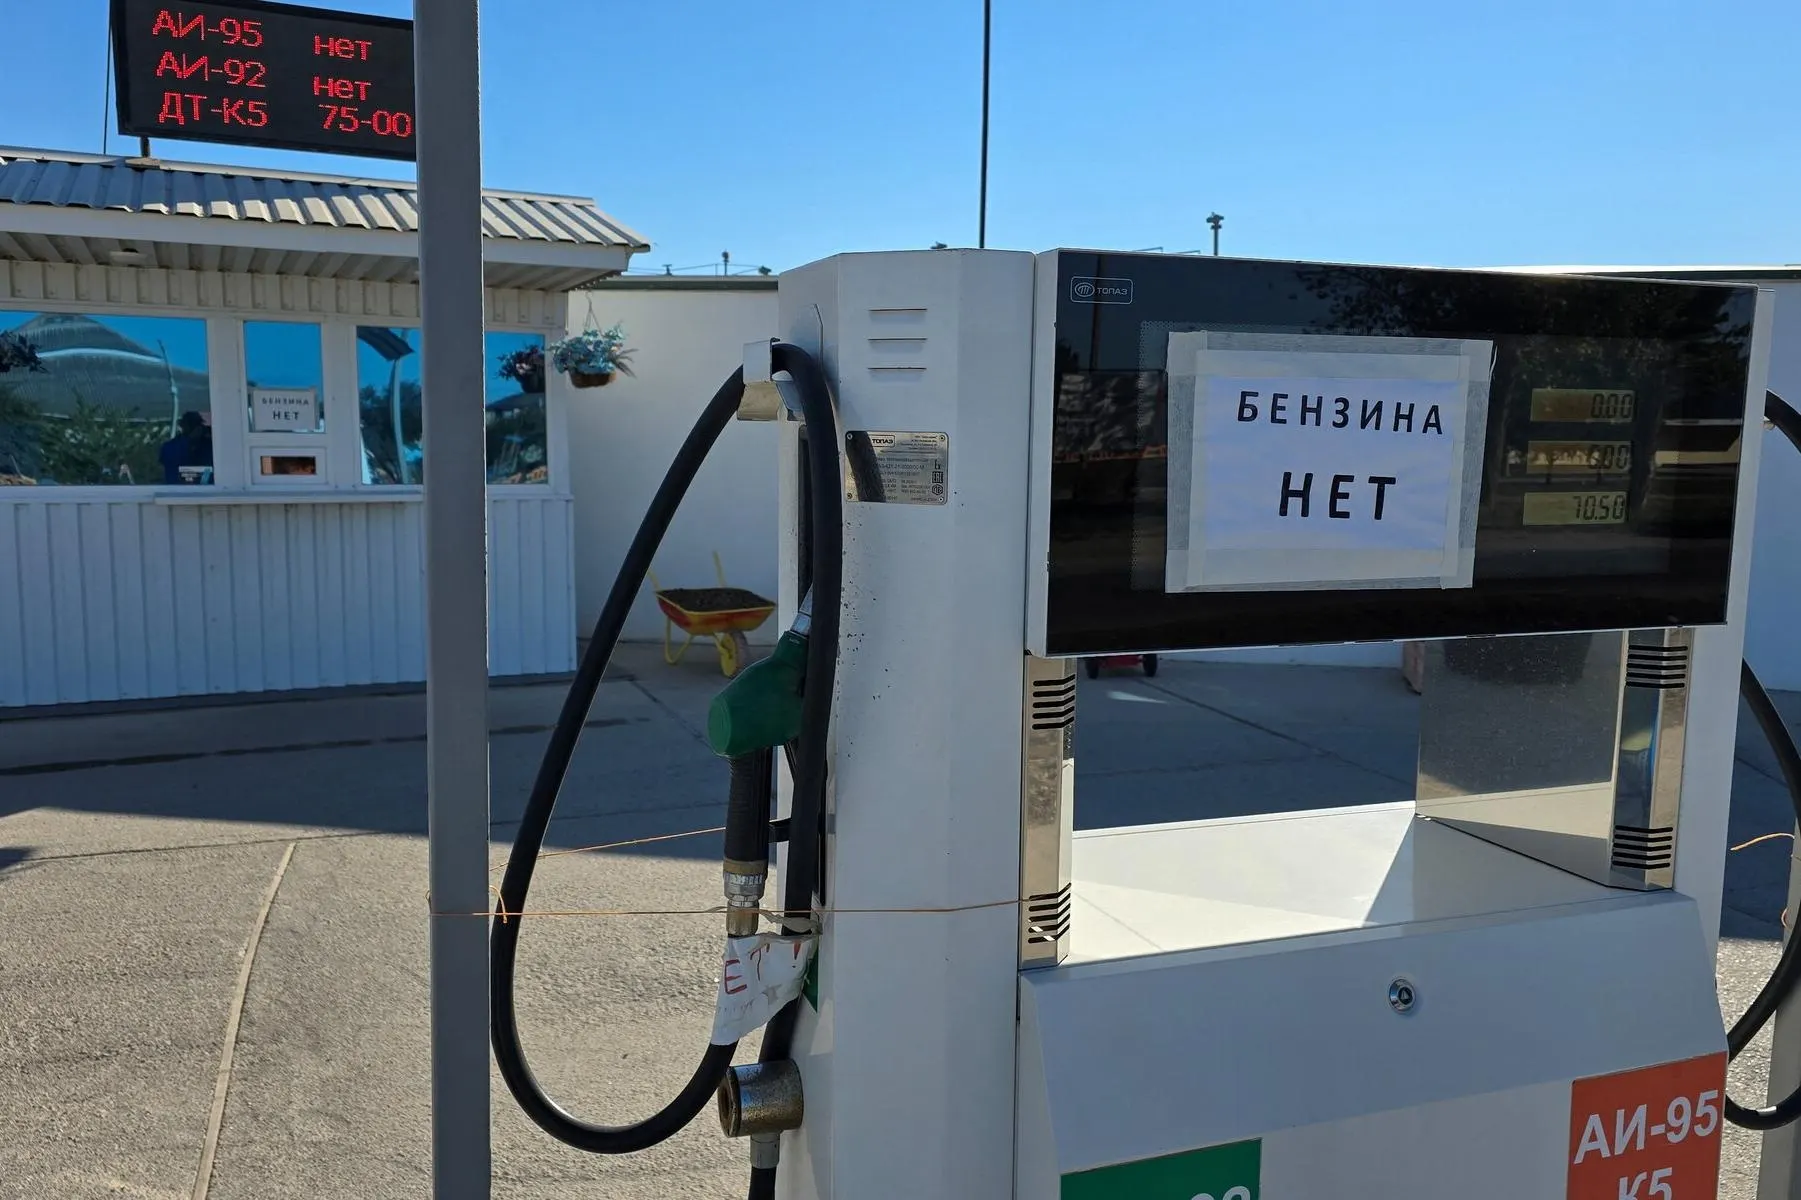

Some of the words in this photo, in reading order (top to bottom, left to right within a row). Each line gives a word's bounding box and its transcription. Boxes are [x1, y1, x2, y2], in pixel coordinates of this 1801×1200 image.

[152, 9, 263, 47] АИ-95
[313, 35, 372, 61] нет
[156, 51, 267, 88] АИ-92
[313, 76, 372, 101] нет
[158, 92, 269, 127] ДТ-К5
[318, 104, 412, 137] 75-00
[1097, 287, 1128, 295] ТОПАЗ
[272, 410, 299, 421] НЕТ
[1237, 390, 1443, 435] БЕНЗИНА
[1279, 471, 1397, 521] НЕТ
[1573, 494, 1625, 520] 70.50
[1573, 1089, 1719, 1165] АИ-95
